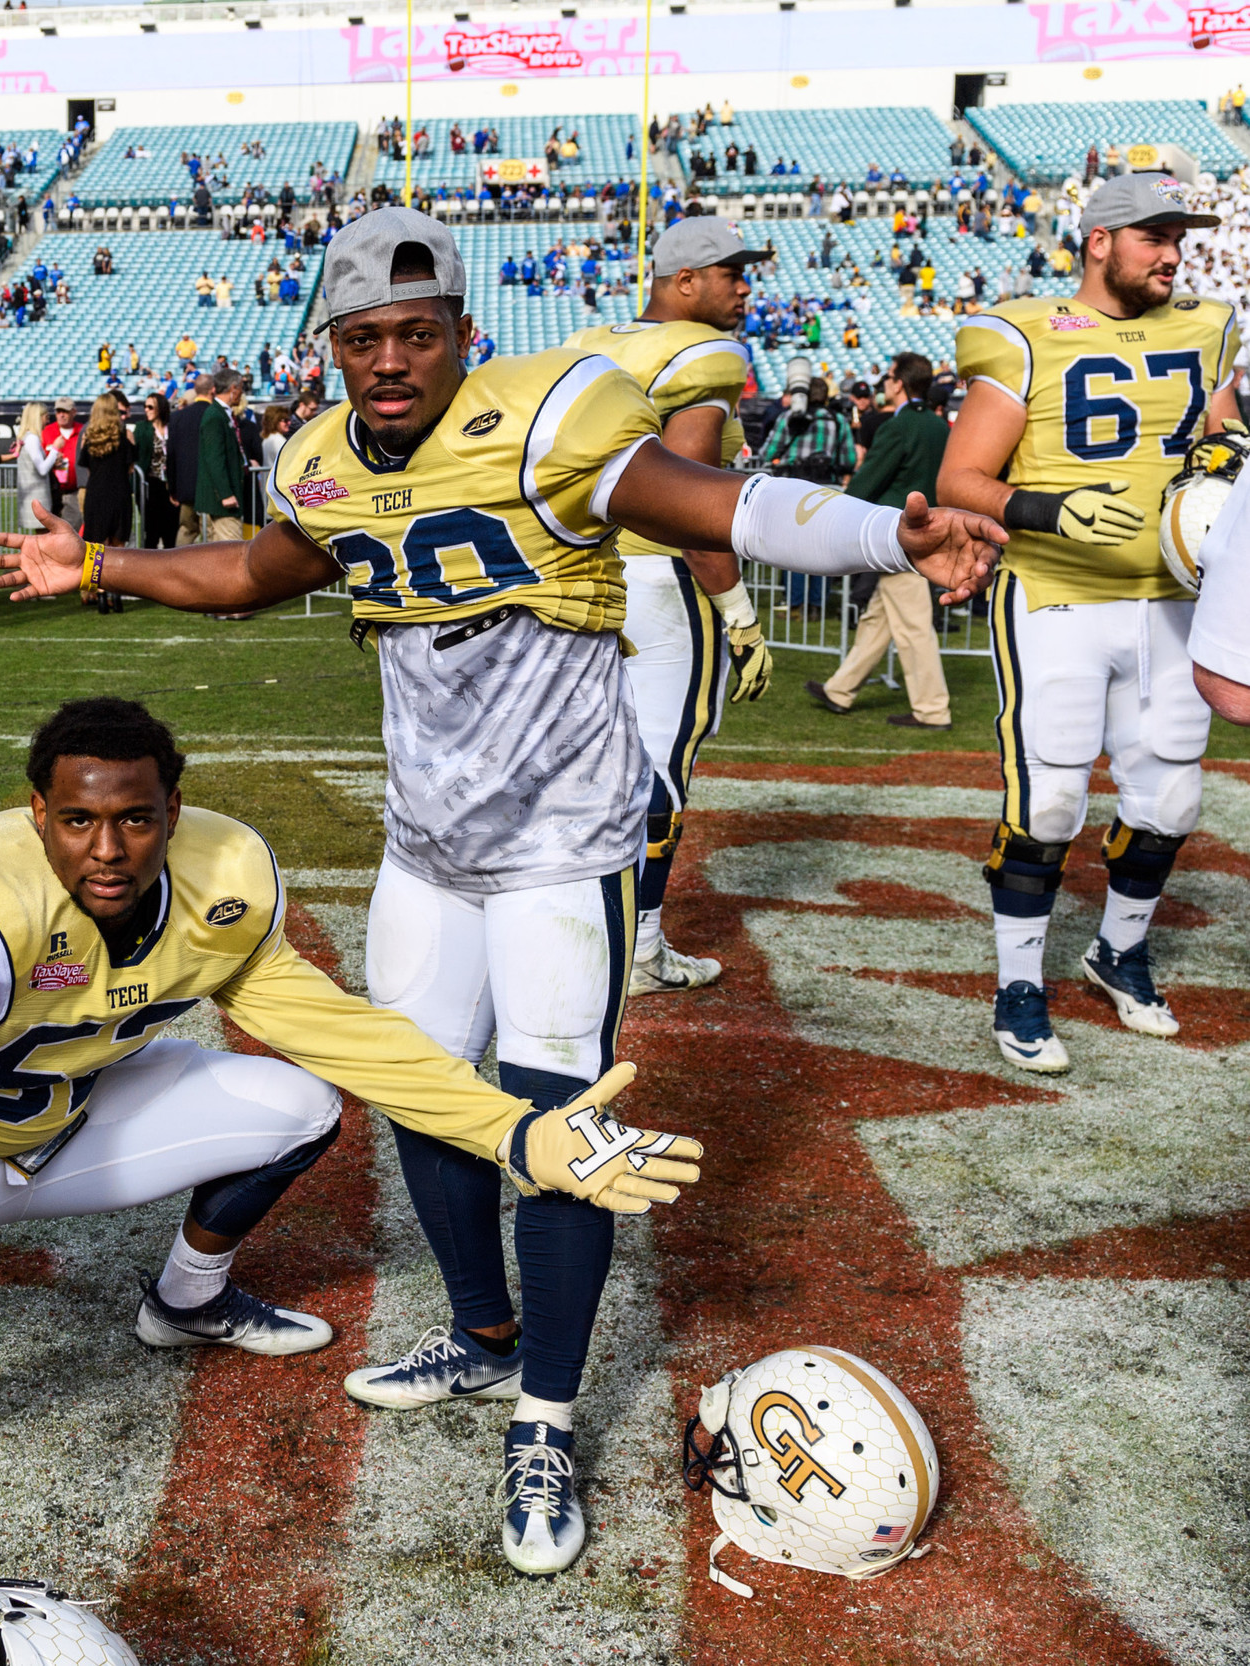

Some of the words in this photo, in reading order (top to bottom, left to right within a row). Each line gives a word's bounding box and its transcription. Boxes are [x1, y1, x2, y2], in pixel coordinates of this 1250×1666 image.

[447, 32, 560, 58] TaxSlayer
[530, 52, 582, 67] BOWL
[1116, 331, 1147, 343] TECH
[1062, 348, 1207, 463] 67
[470, 408, 500, 430] ACC
[298, 469, 323, 483] RUSSELL
[290, 478, 336, 498] TaxSlayer
[326, 487, 349, 500] BOWL
[371, 488, 413, 514] TECH
[211, 899, 245, 921] ACC
[46, 949, 73, 963] RUSSELL
[34, 962, 84, 979] TaxSlayer
[67, 975, 89, 984] BOWL
[106, 983, 149, 1009] TECH
[750, 1390, 847, 1503] GT
